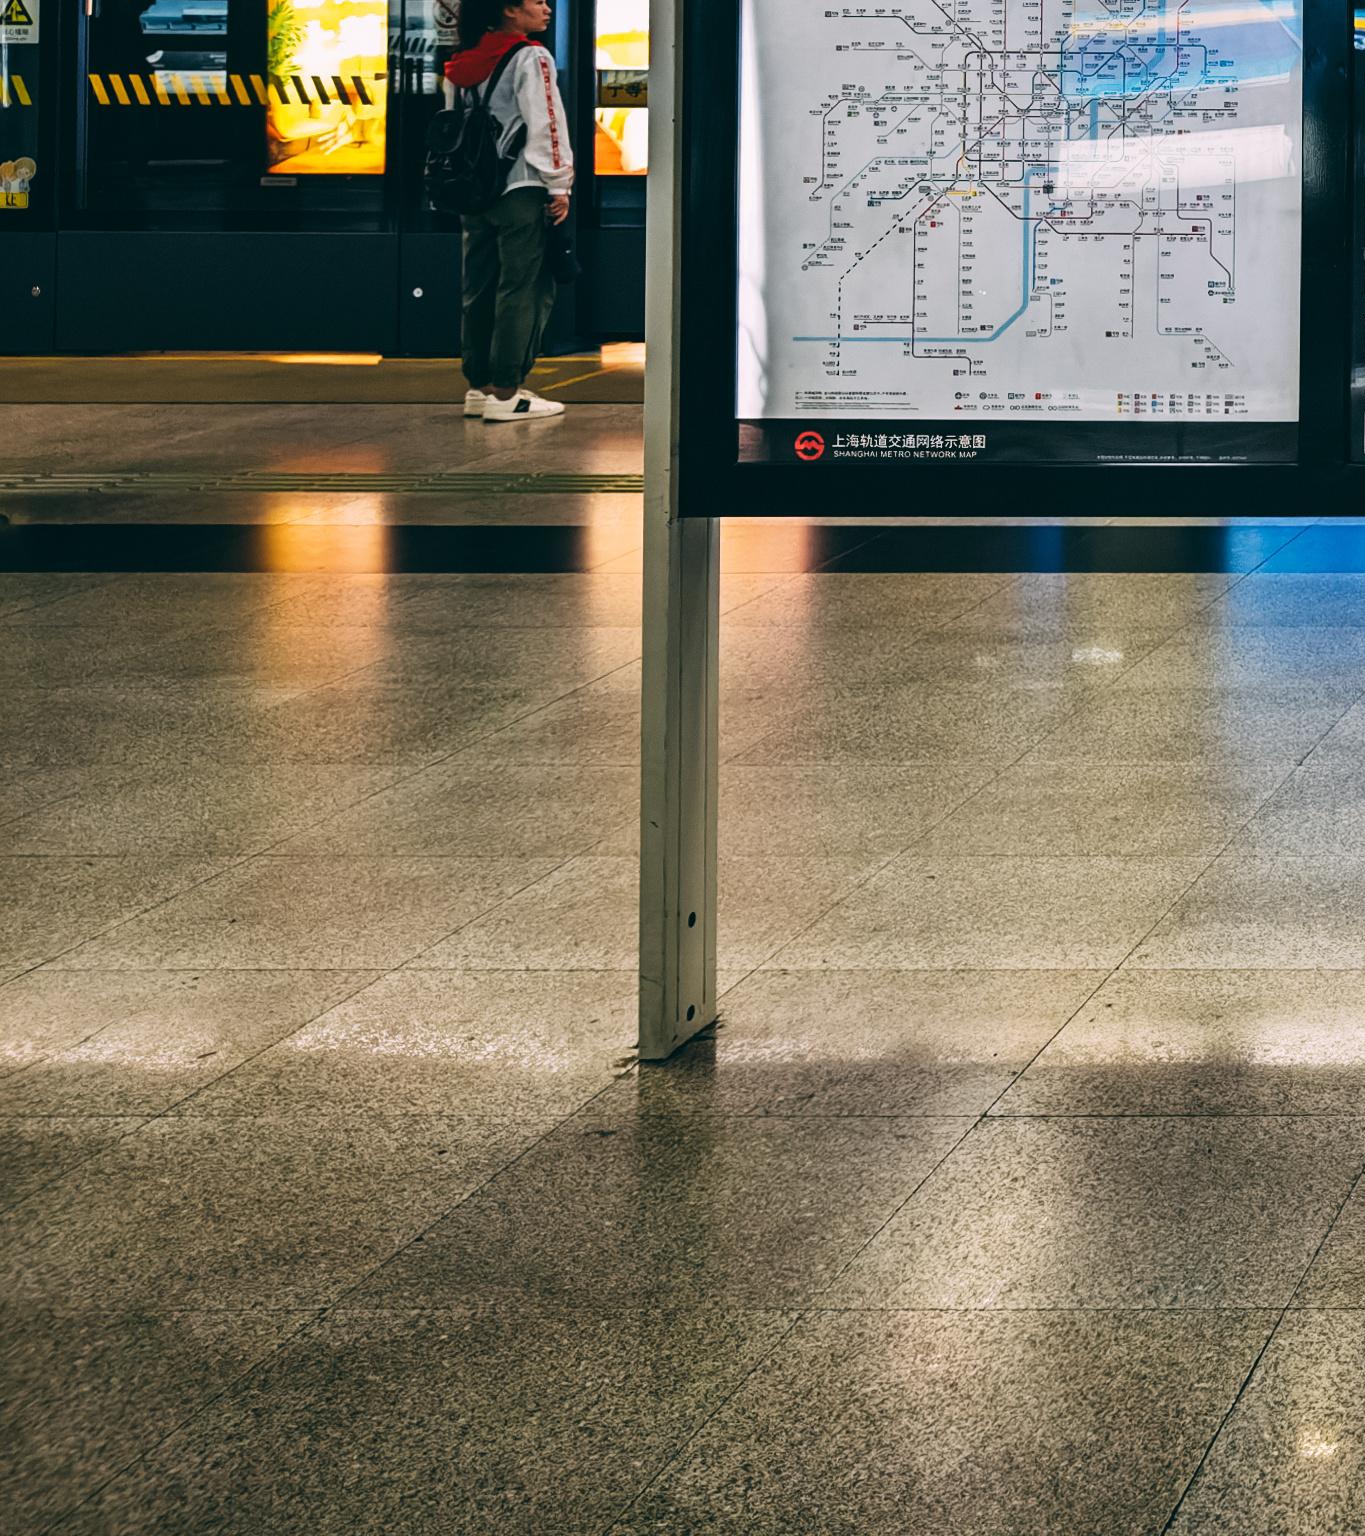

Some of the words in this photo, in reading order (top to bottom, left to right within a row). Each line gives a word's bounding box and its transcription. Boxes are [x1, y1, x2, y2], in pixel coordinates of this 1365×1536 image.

[832, 434, 986, 448] 上海轨道交通网络示意图
[834, 450, 878, 458] SHANGHAI
